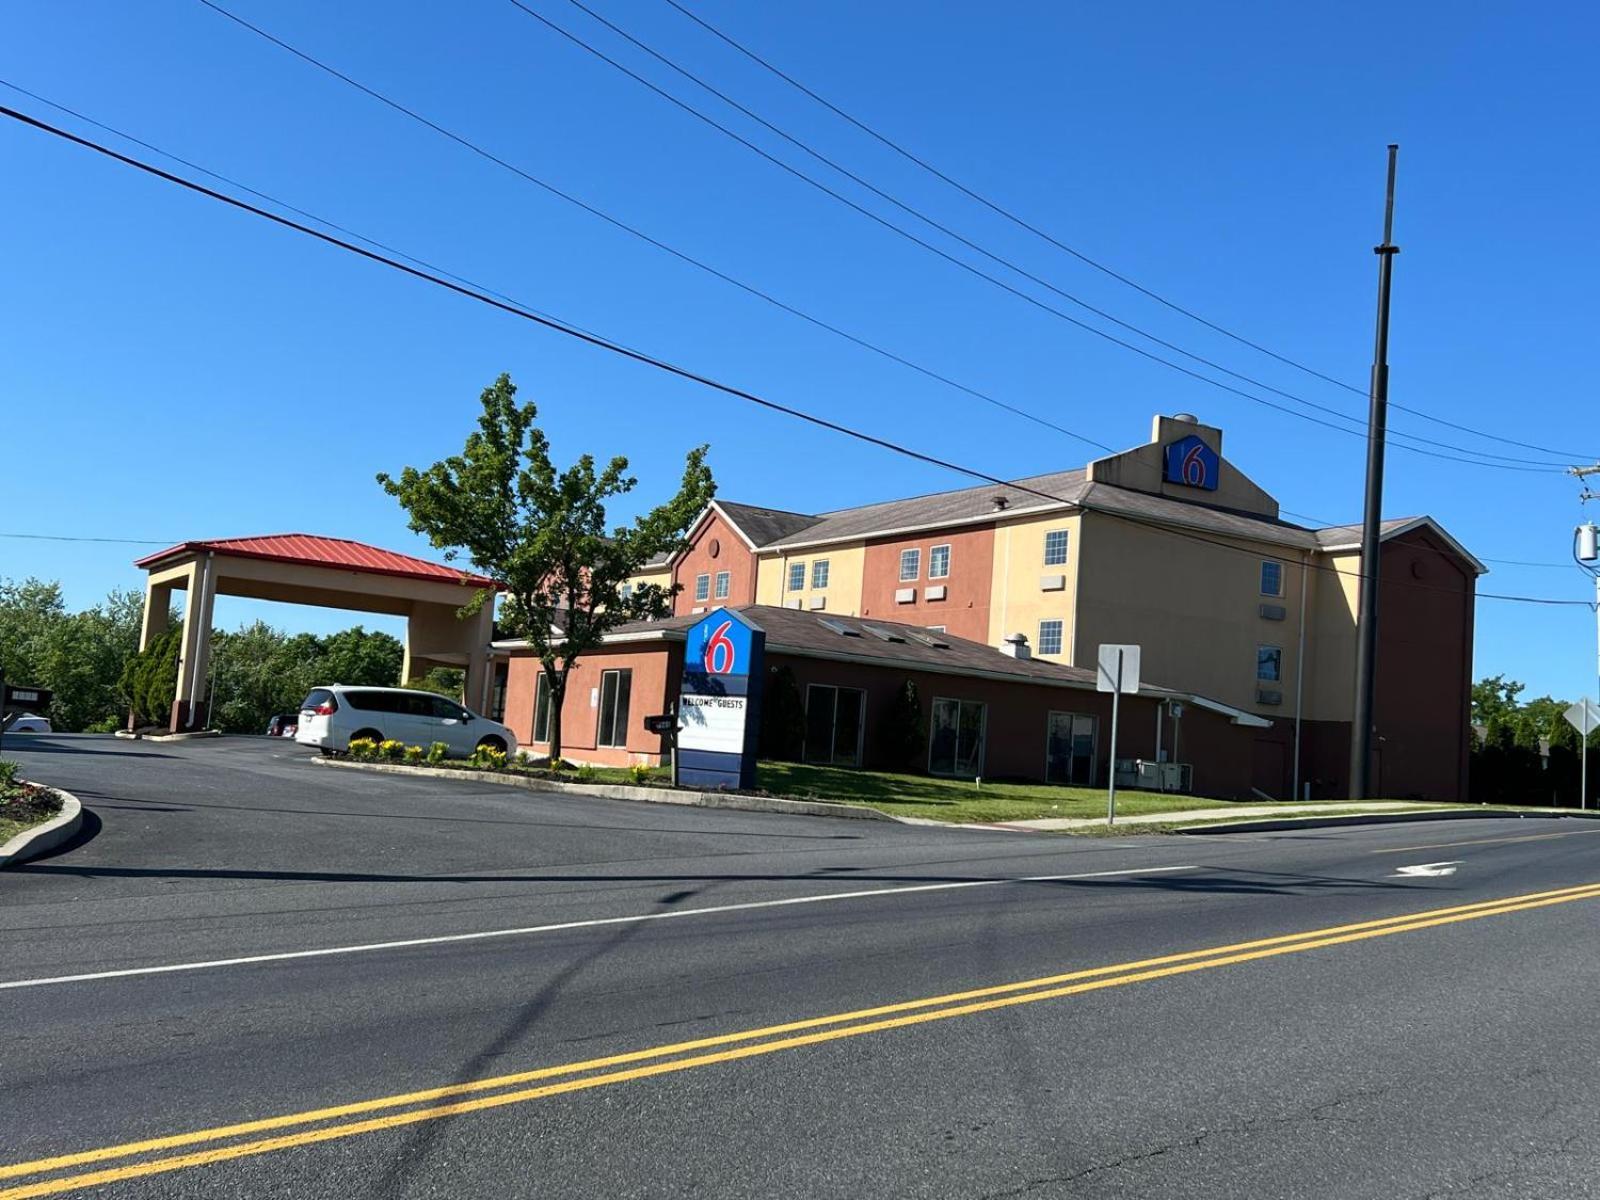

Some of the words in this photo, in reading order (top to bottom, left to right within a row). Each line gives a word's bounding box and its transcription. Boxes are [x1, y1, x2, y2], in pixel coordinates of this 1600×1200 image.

[1182, 444, 1205, 487] 6
[704, 620, 735, 673] 6
[682, 697, 714, 707] WELCOME
[717, 699, 743, 709] GUESTS
